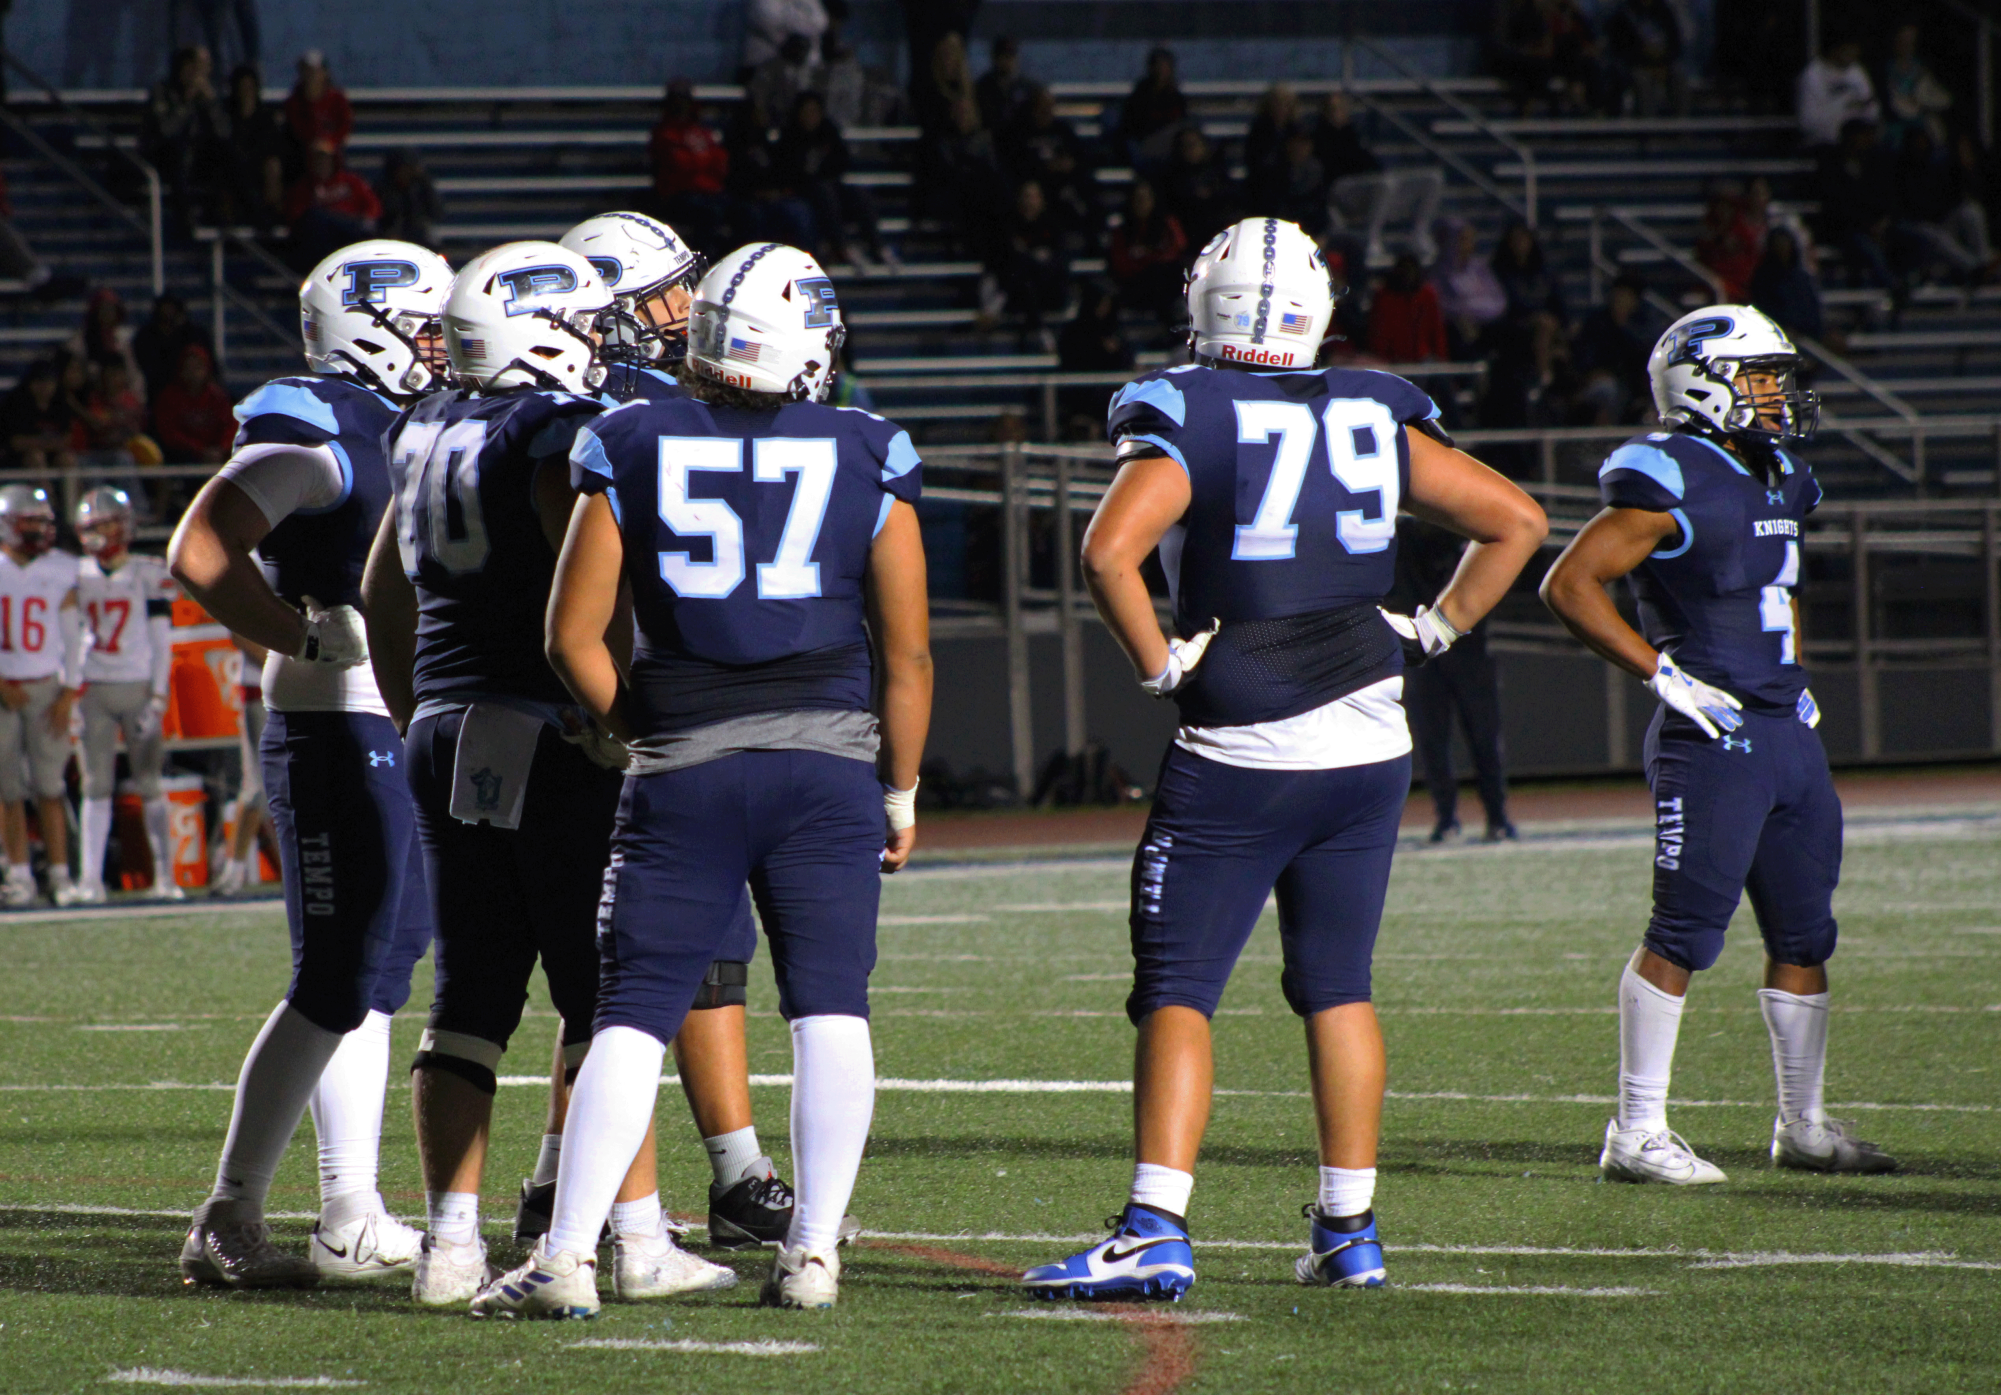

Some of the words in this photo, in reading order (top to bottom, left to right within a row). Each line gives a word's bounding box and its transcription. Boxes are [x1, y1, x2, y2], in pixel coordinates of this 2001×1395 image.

[343, 260, 420, 306] P
[498, 264, 578, 318] P
[1222, 344, 1294, 367] Riddell
[1667, 316, 1735, 367] P
[393, 419, 491, 573] 70
[1230, 398, 1399, 560] 79
[657, 435, 838, 600] 57
[1753, 519, 1799, 537] KNIGHTS
[0, 595, 47, 652] 16
[86, 599, 131, 653] 17
[301, 832, 335, 915] TEMPO
